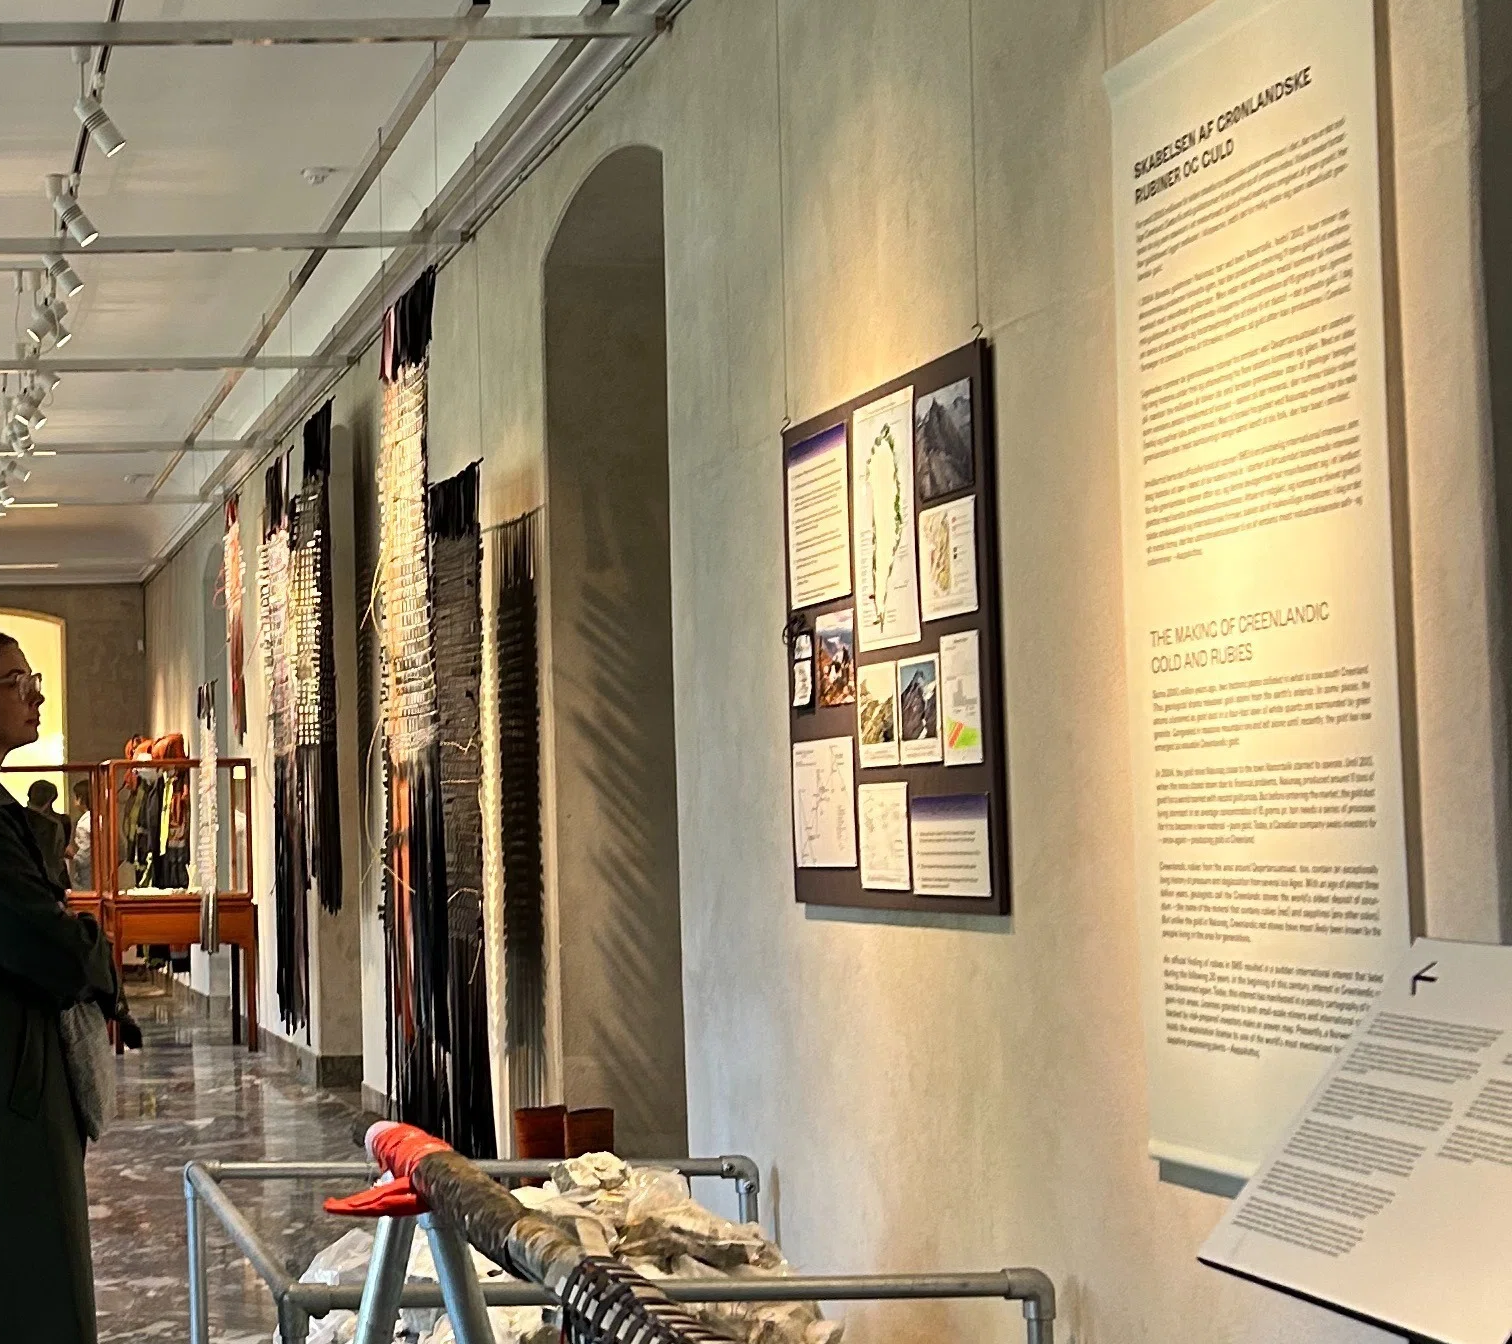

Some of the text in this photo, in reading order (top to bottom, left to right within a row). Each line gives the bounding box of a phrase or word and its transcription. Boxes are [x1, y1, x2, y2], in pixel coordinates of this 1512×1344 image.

[1134, 129, 1197, 180] SKABELSEN
[1197, 119, 1215, 144] AF
[1135, 166, 1182, 205] RUBINER
[1150, 628, 1173, 647] THE
[1175, 620, 1218, 644] MAKING
[1220, 617, 1236, 637] OF
[1184, 649, 1208, 669] AND
[1210, 642, 1253, 665] RUBIES
